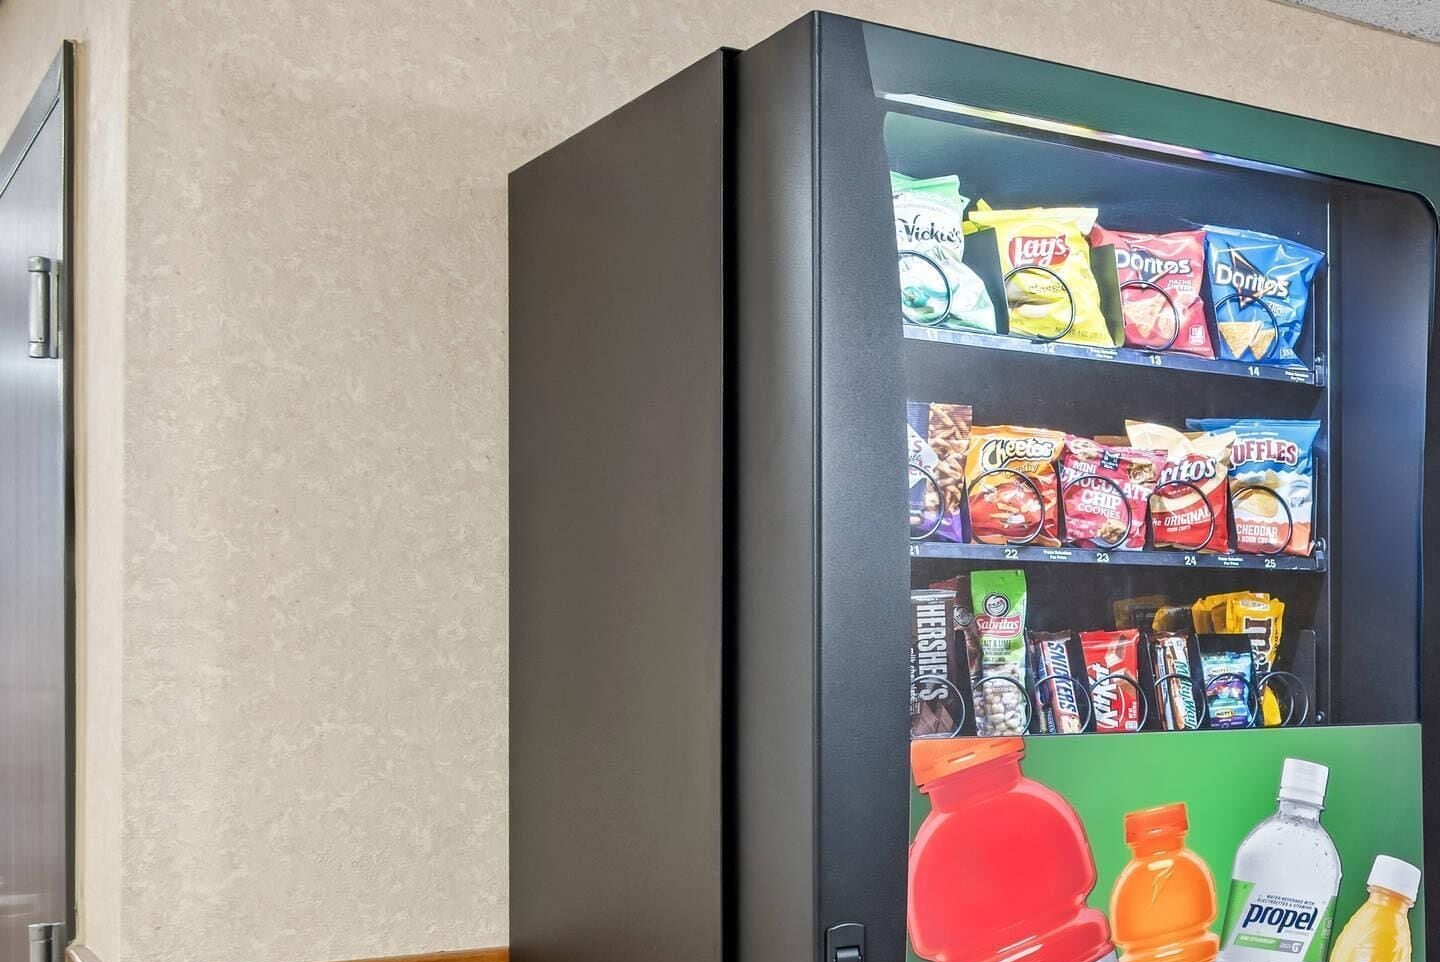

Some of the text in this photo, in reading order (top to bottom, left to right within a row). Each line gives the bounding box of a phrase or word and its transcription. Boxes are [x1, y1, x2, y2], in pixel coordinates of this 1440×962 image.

[903, 214, 962, 247] Vickie's
[1014, 235, 1067, 267] Lay's
[1115, 249, 1192, 274] Doritos
[1216, 264, 1290, 297] Doritos
[1149, 355, 1162, 366] 13
[1247, 366, 1260, 377] 14
[982, 438, 1056, 473] Cheetos
[1232, 438, 1297, 466] UFFLES
[1072, 461, 1097, 474] MINI
[1081, 489, 1121, 510] CHIP
[1078, 503, 1121, 520] COOKIES
[1164, 505, 1211, 526] ORIGINAL
[1236, 524, 1278, 538] CHEDDAR
[1005, 549, 1019, 559] 22
[1097, 553, 1110, 562] 23
[1184, 555, 1197, 566] 24
[1264, 558, 1277, 568] 25
[976, 618, 1019, 630] Sabritas
[917, 603, 949, 701] HERSHEY'S
[1242, 904, 1319, 933] propel
